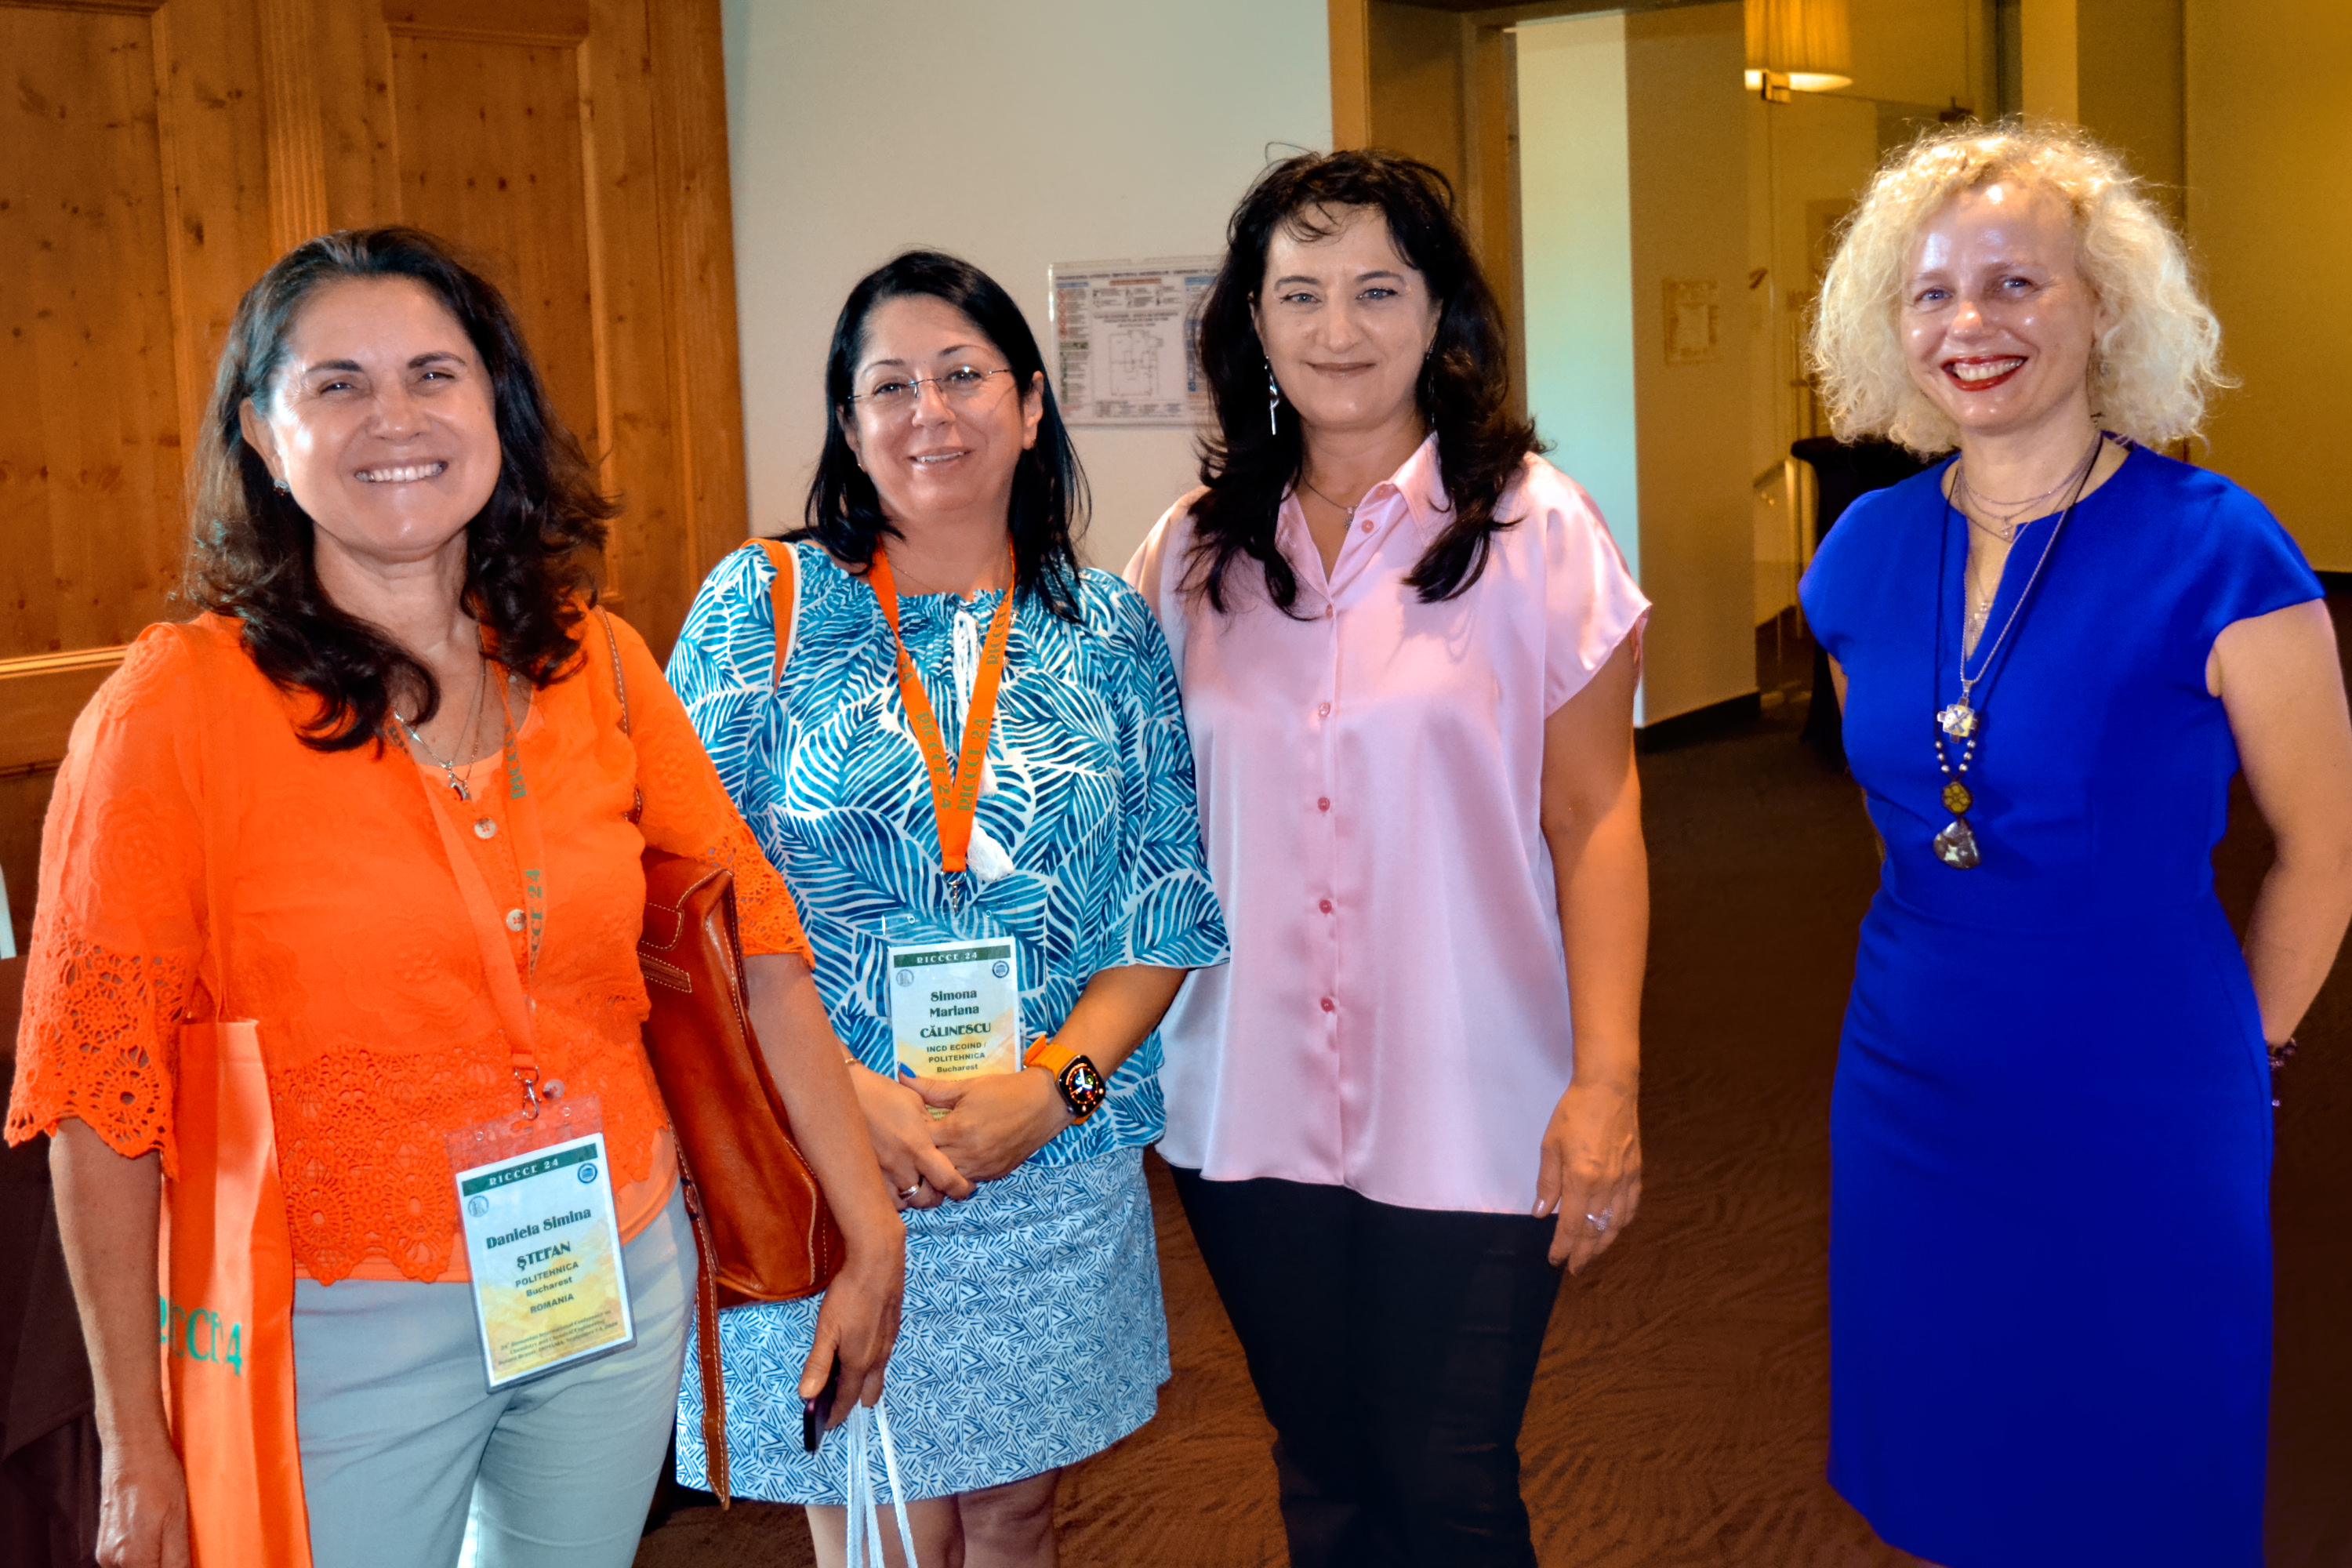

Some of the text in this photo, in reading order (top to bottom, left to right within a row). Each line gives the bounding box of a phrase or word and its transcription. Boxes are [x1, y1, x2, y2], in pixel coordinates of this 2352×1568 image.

[916, 712, 952, 809] RICCCE 24
[957, 718, 988, 811] RICCCE 24
[524, 869, 543, 898] 24
[916, 954, 960, 964] RICCCE
[931, 990, 977, 1002] Simona
[930, 1006, 979, 1018] Mariana
[920, 1022, 991, 1039] CĂLINESCU
[927, 1044, 947, 1053] INCD
[950, 1042, 982, 1051] ECOIND
[929, 1052, 985, 1063] POLITEHNICA
[937, 1064, 978, 1073] Bucharest
[489, 1159, 559, 1186] RICCCE 24
[486, 1208, 591, 1249] Daniela Simina
[515, 1261, 579, 1288] POLITEHNICA
[526, 1276, 573, 1298] Bucharest
[530, 1293, 575, 1314] ROMANIA
